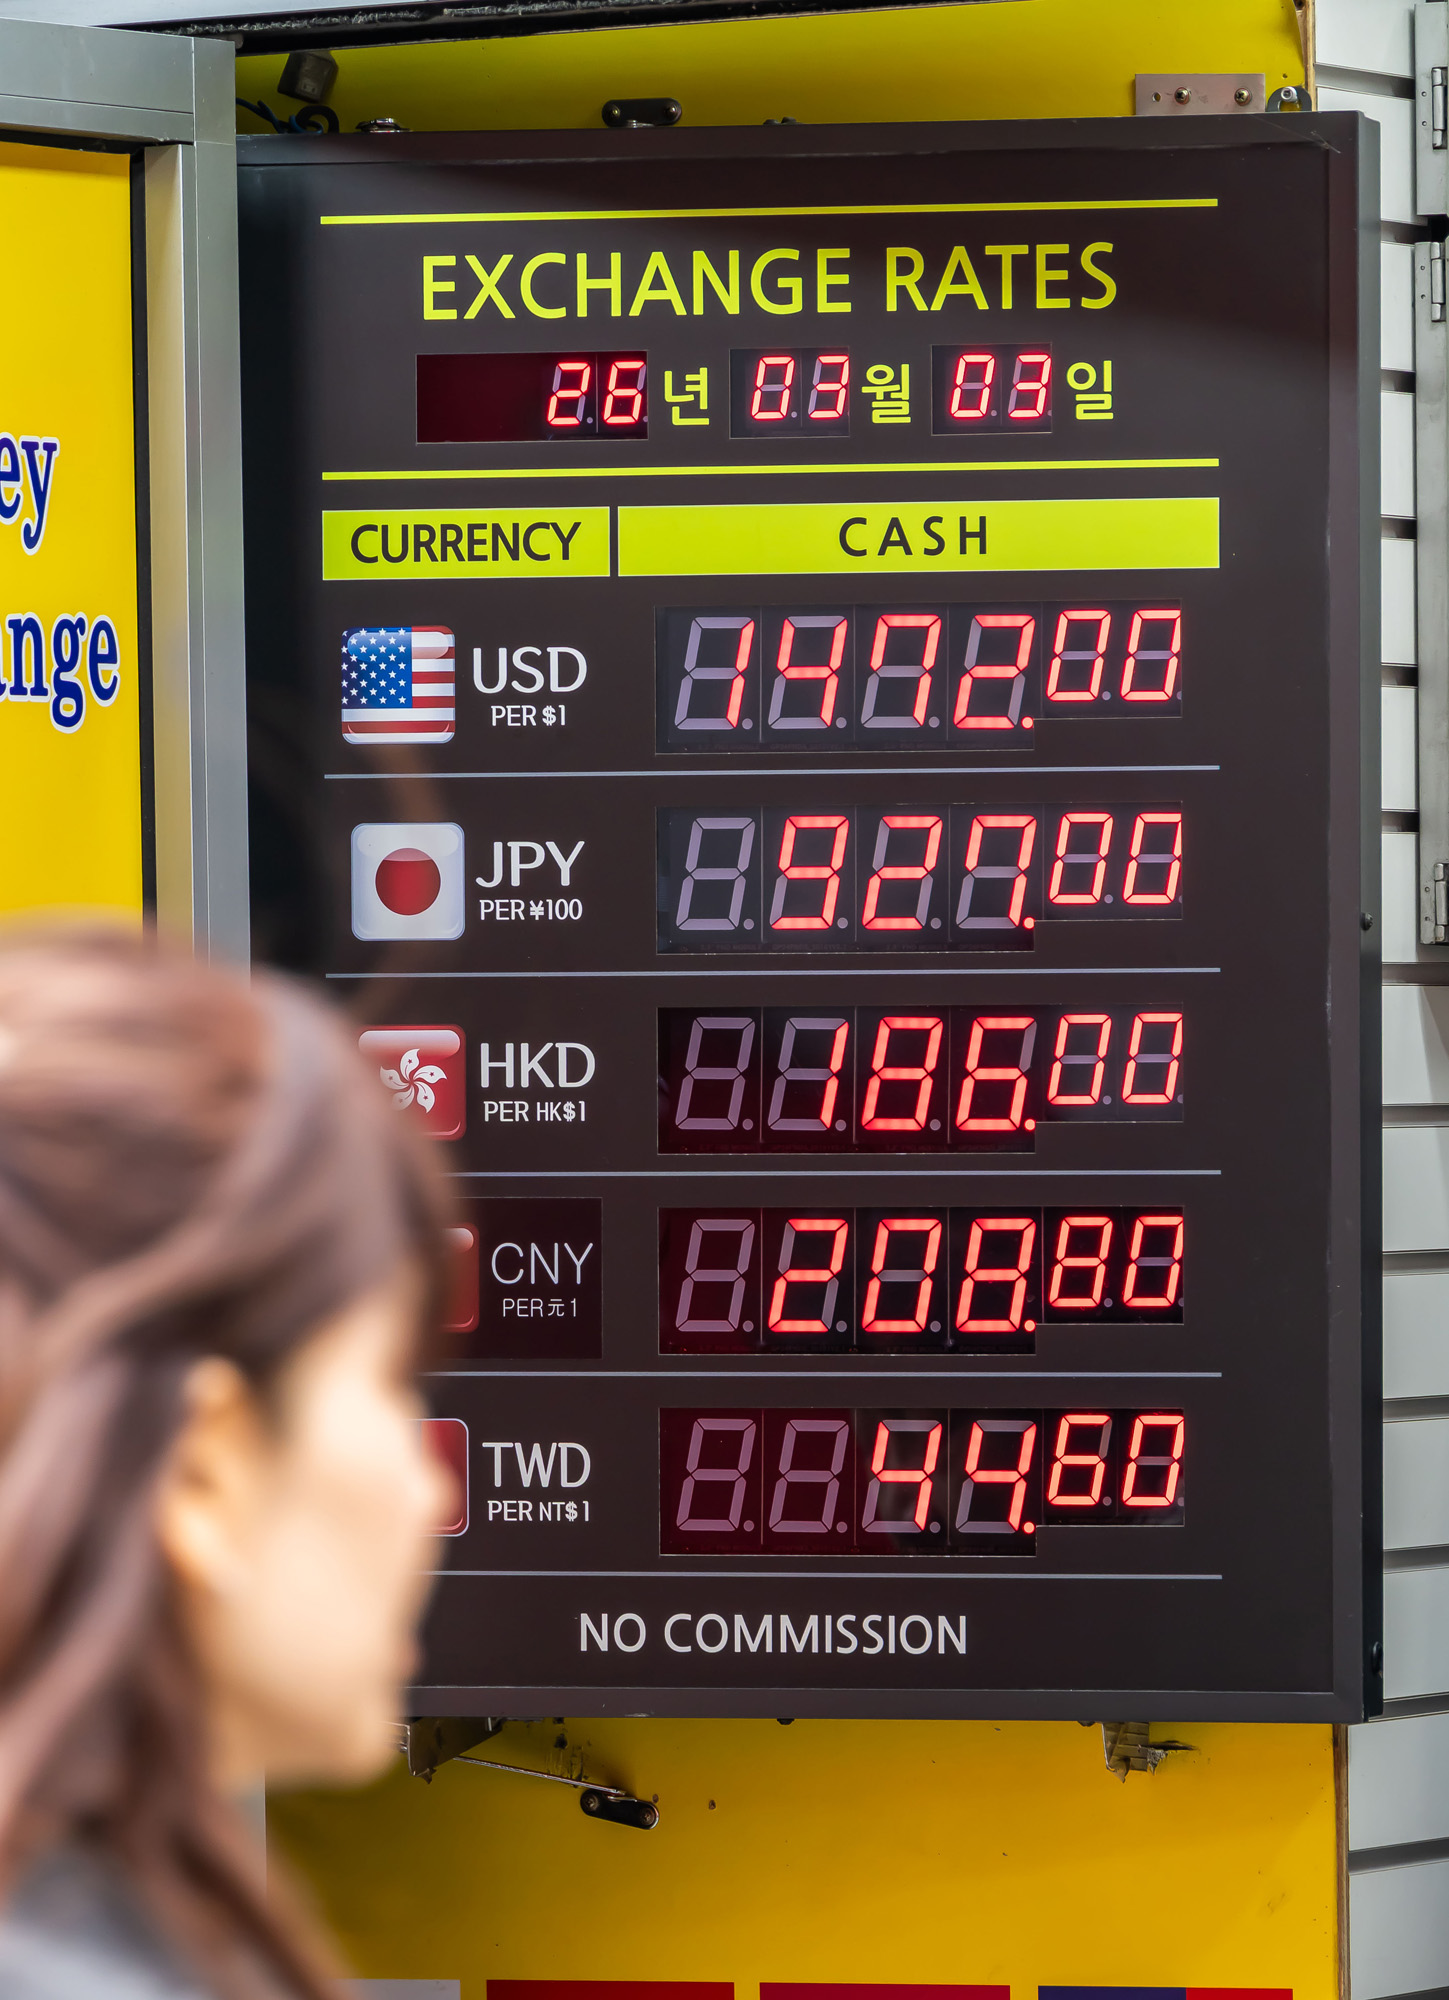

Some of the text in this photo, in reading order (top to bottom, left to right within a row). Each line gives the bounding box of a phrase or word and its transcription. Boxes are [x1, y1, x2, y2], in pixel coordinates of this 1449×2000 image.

[423, 242, 1116, 320] EXCHANGE RATES
[351, 522, 582, 564] CURRENCY
[839, 516, 987, 557] CASH
[0, 616, 118, 728] nge
[473, 646, 588, 694] USD
[490, 704, 566, 727] PER $1
[475, 840, 586, 888] JPY
[479, 898, 583, 921] PER ¥100
[480, 1042, 596, 1089] HKD
[483, 1100, 586, 1123] PER HK$1
[491, 1242, 594, 1285] CNY
[483, 1442, 591, 1488] TWD
[487, 1500, 590, 1522] PER NT$1
[580, 1612, 967, 1655] NO COMMISSION
